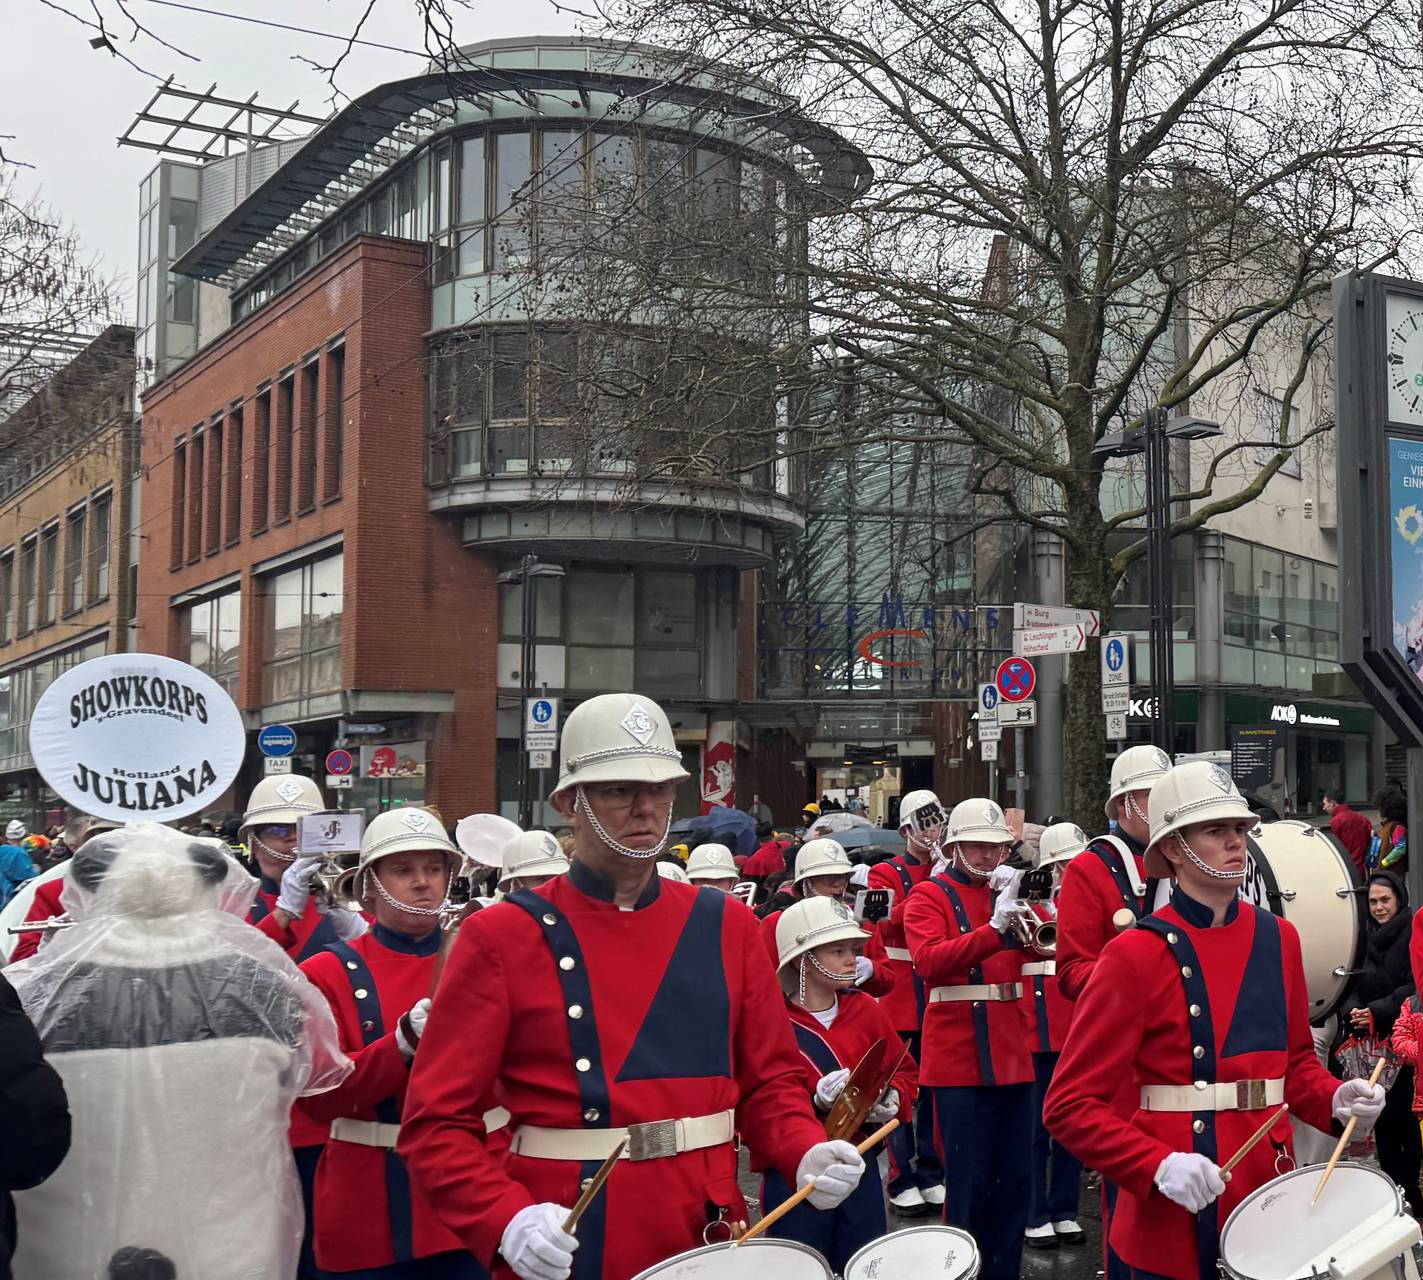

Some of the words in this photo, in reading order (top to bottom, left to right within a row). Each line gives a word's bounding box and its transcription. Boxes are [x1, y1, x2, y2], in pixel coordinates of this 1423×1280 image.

[781, 592, 999, 632] CLEMENS
[1034, 608, 1049, 620] Burg
[1108, 673, 1122, 682] ZONE
[70, 675, 208, 729] SHOWKORPS
[95, 707, 185, 723] 's-Gravendeel
[268, 759, 288, 768] TAXI
[112, 765, 181, 779] Holland
[73, 759, 217, 811] JULIANA
